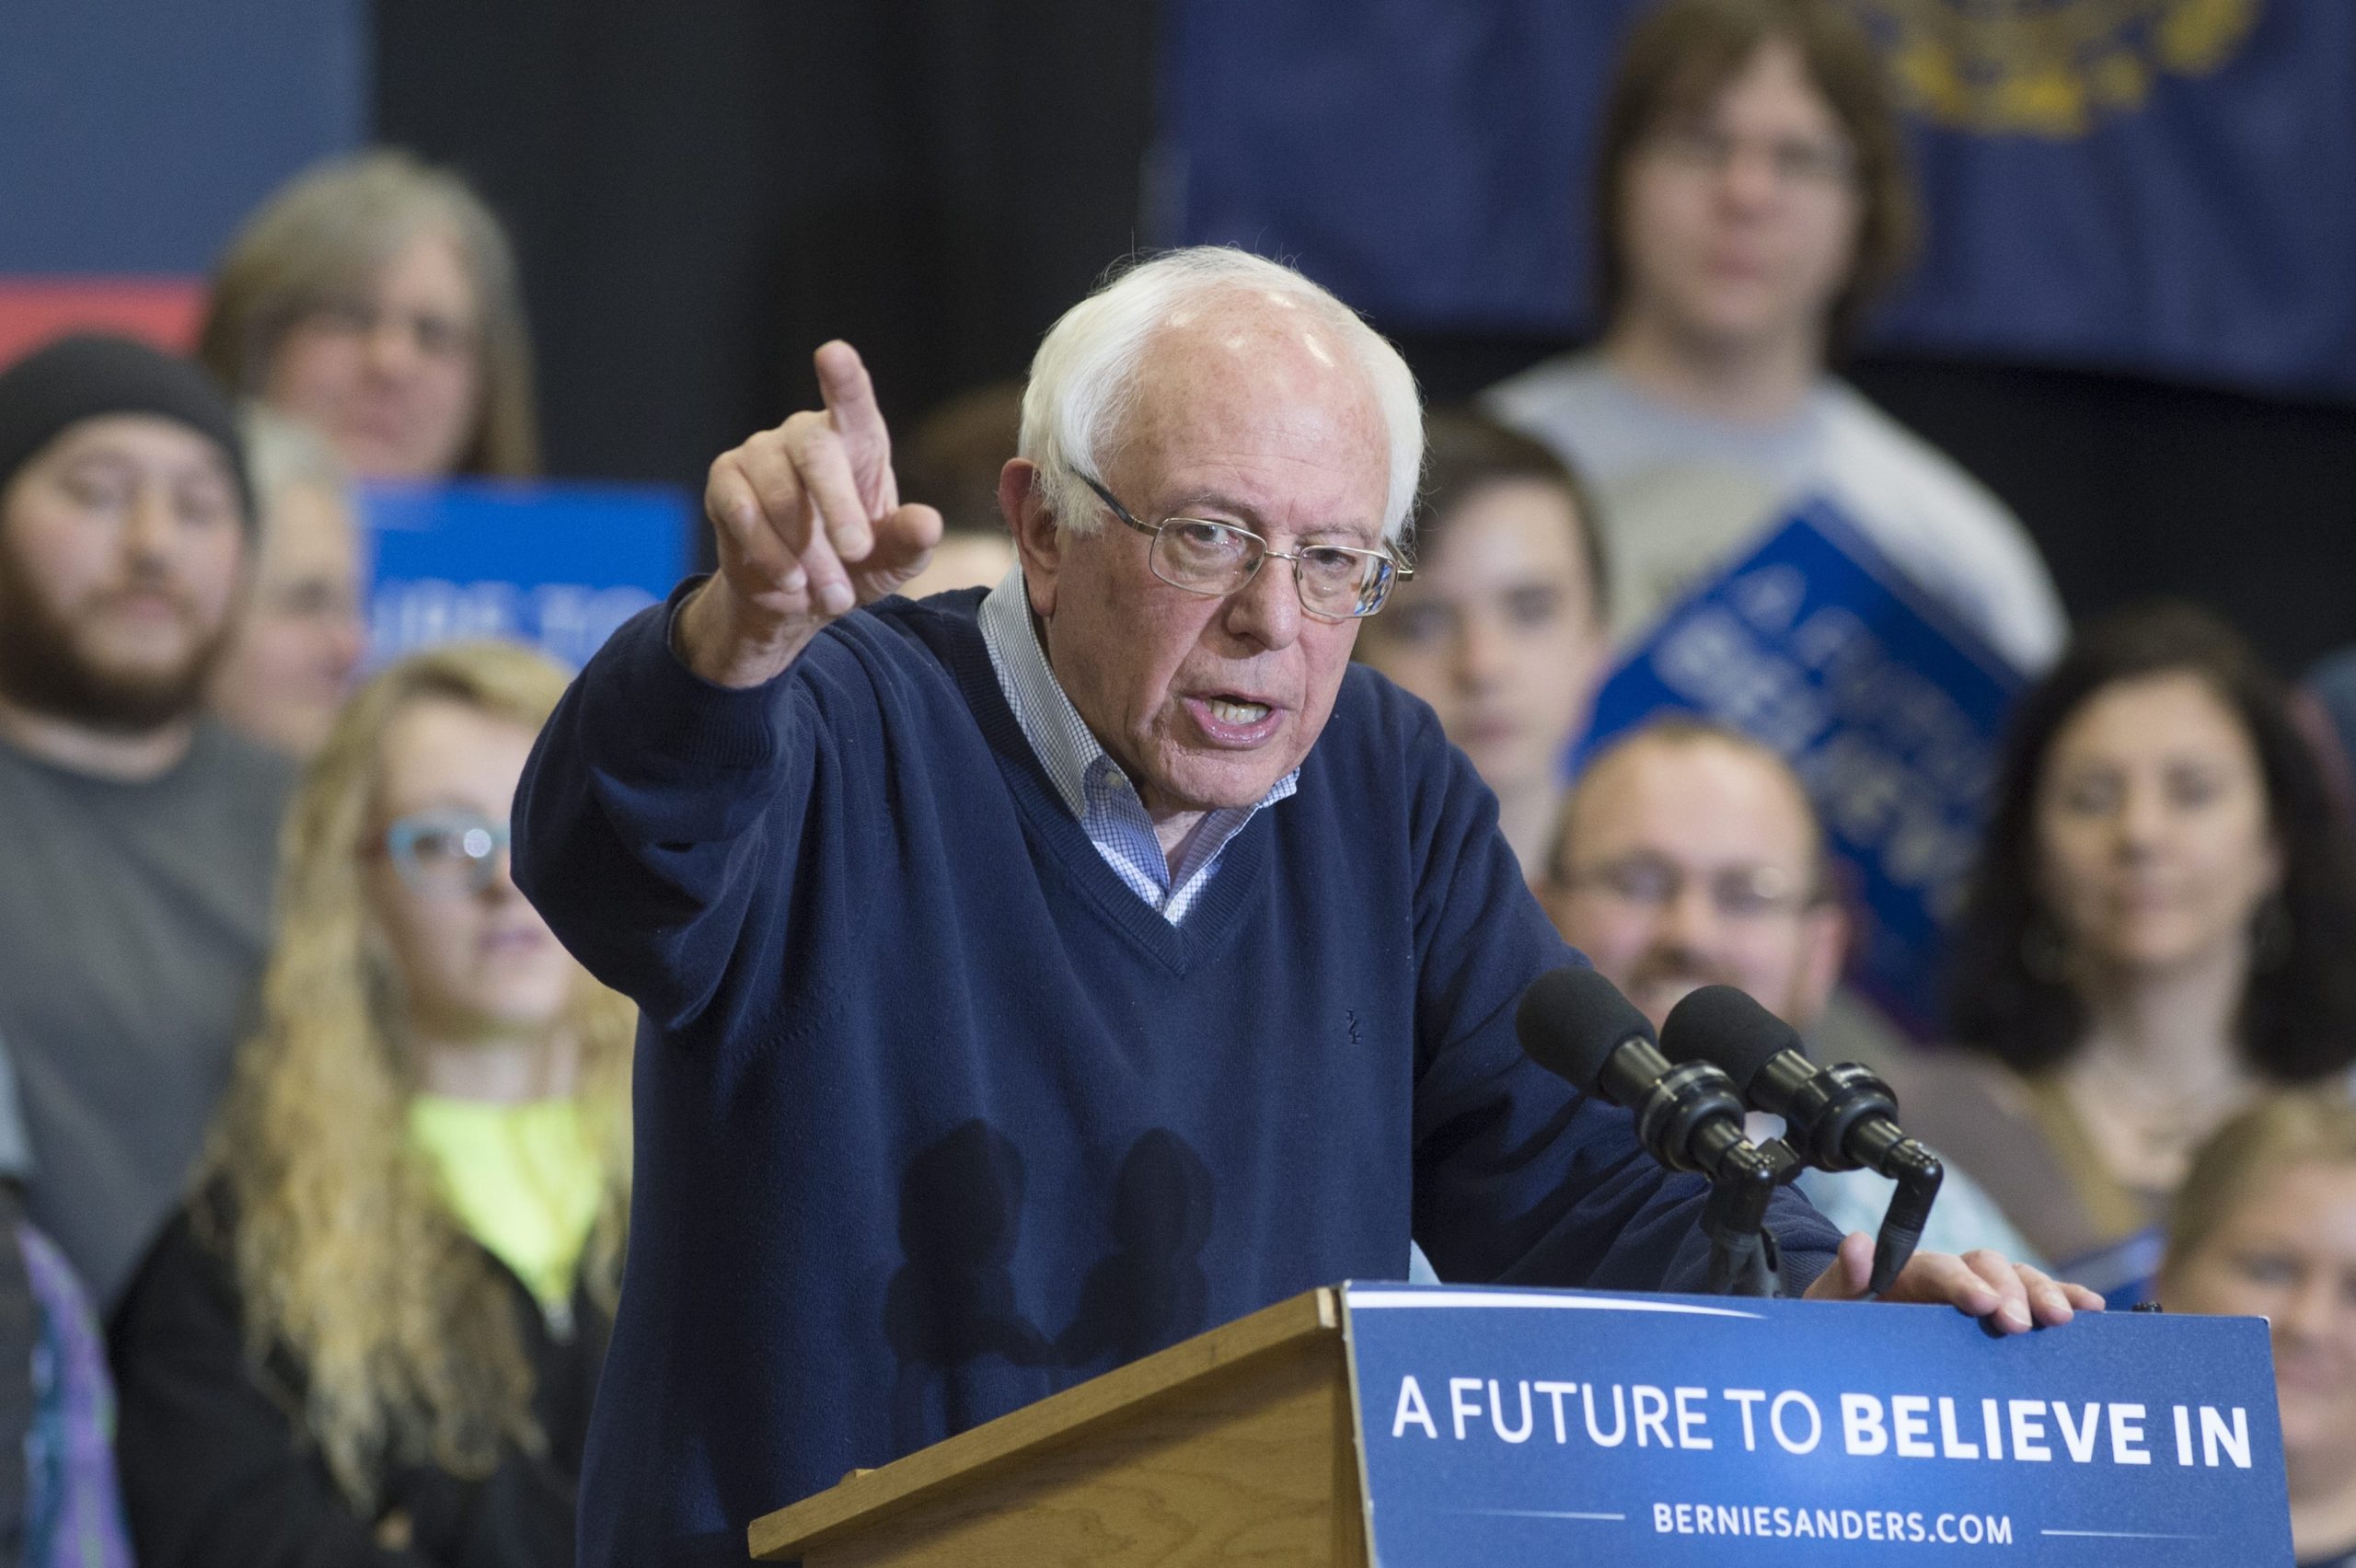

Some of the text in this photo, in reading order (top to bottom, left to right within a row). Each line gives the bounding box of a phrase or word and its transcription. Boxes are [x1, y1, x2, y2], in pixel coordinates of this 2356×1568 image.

[1392, 1375, 2254, 1470] A FUTURE TO BELIEVE IN
[1653, 1503, 2013, 1545] BERNIESANDERS.COM
